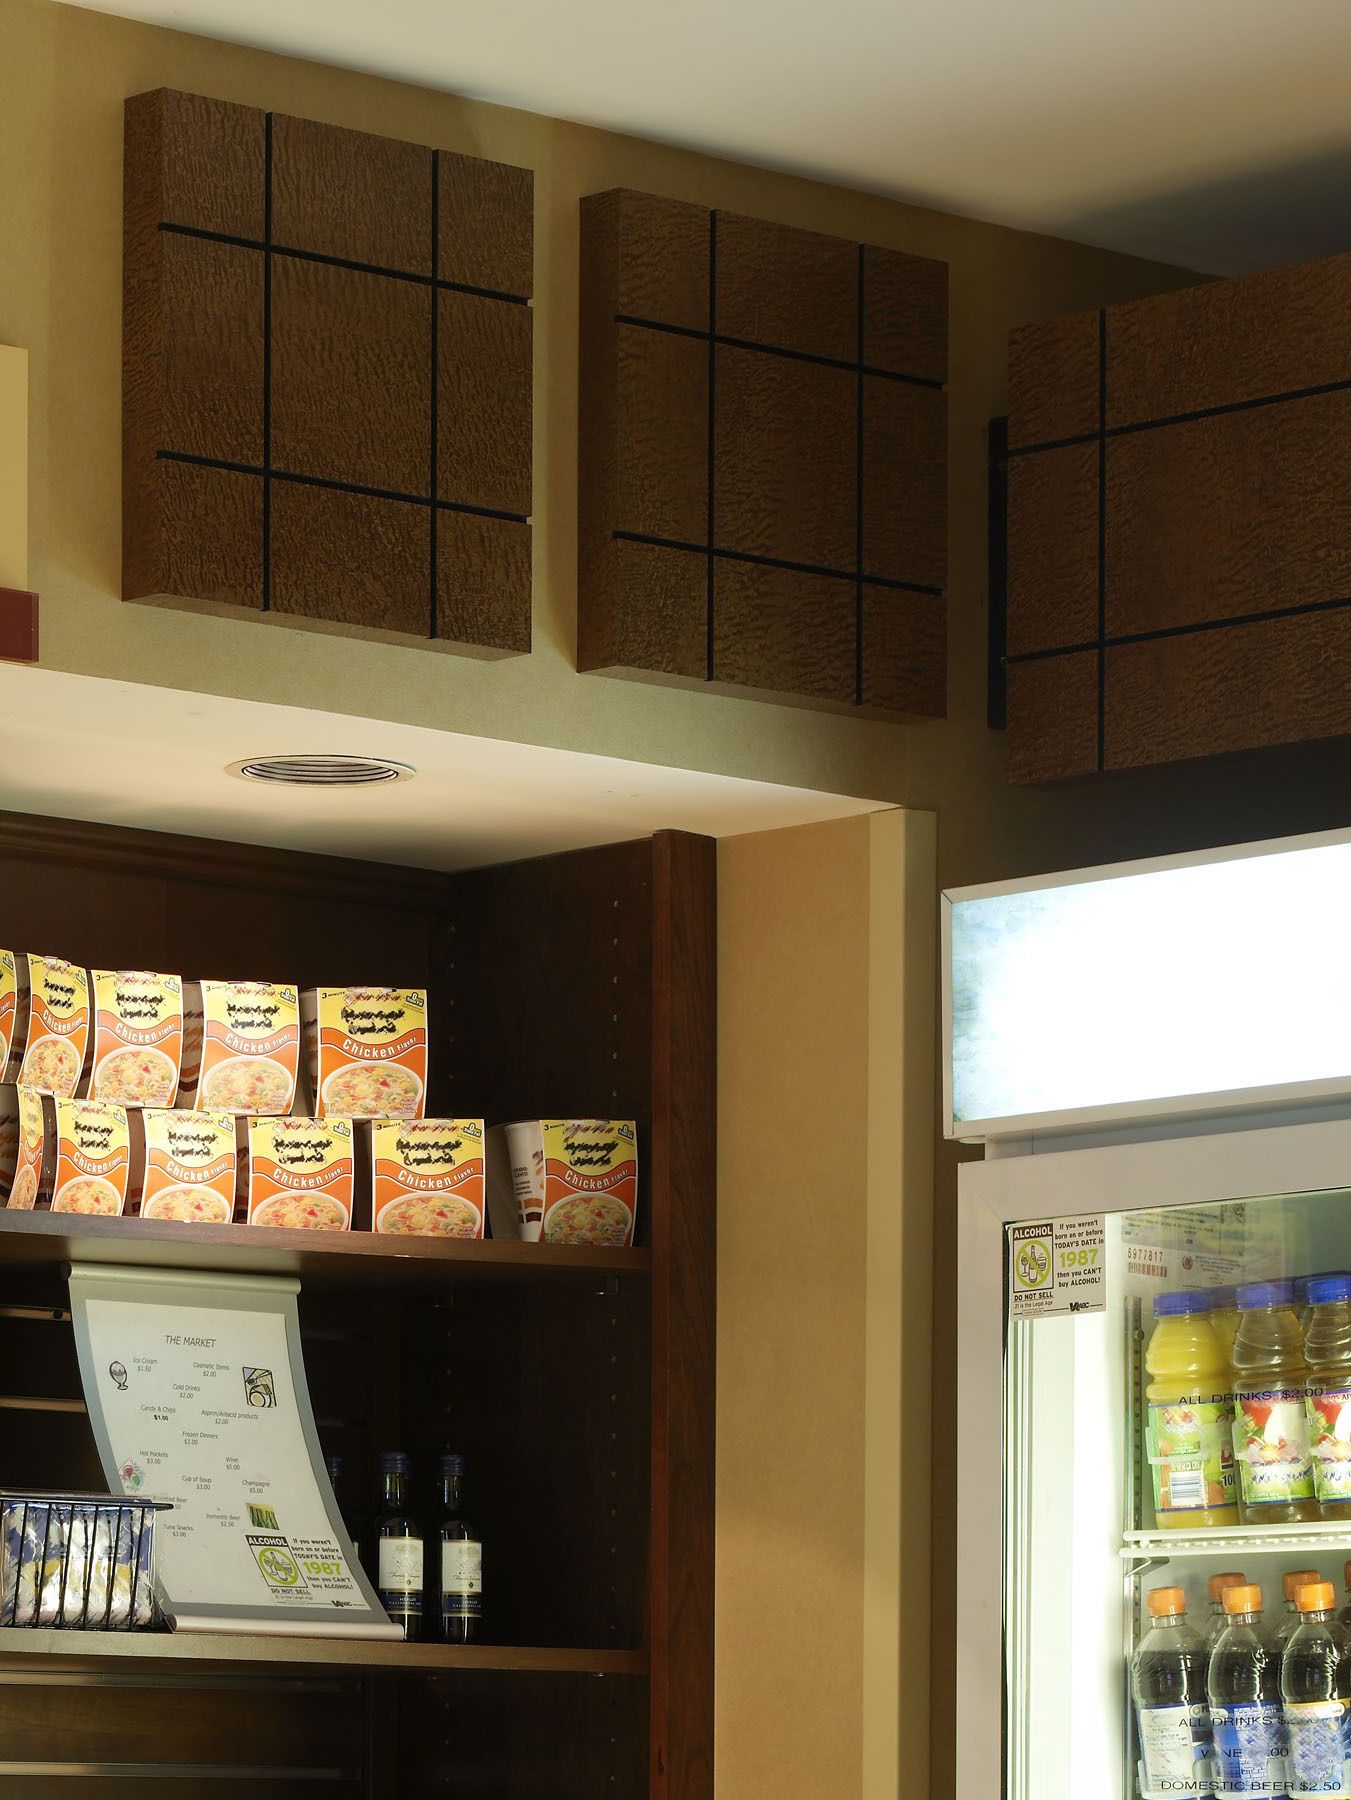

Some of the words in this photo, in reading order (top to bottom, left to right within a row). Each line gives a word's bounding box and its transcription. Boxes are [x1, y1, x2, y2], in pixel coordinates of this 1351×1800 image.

[43, 1009, 71, 1032] Chicken
[115, 1022, 157, 1043] Chicken
[226, 1033, 271, 1052] Chicken
[343, 1039, 395, 1059] Chicken
[397, 1037, 417, 1051] Flavor
[73, 1152, 107, 1172] Chicken
[167, 1161, 209, 1180] Chicken
[273, 1168, 323, 1187] Chicken
[325, 1167, 344, 1180] Flavor
[398, 1170, 451, 1189] Chicken
[454, 1167, 474, 1182] Flavor
[564, 1170, 610, 1189] Chicken
[1014, 1226, 1052, 1239] ALCOHOL
[1086, 1229, 1103, 1237] before
[1055, 1241, 1079, 1249] TODAY'S
[1060, 1248, 1099, 1268] 1987
[1128, 1248, 1163, 1262] 6977817
[1083, 1267, 1102, 1275] CAN'T
[1070, 1277, 1100, 1286] ALCOHOL!
[165, 1335, 181, 1345] THE
[183, 1337, 216, 1348] MARKET
[193, 1362, 214, 1370] Cosmetic
[1178, 1396, 1207, 1404] ALL
[1212, 1391, 1272, 1404] DRINKS
[1282, 1388, 1324, 1399] $2.00
[141, 1405, 157, 1413] Candy
[248, 1537, 288, 1546] ALCOHOL
[303, 1562, 342, 1575] 1987
[1178, 1718, 1207, 1728] ALL
[1212, 1716, 1272, 1727] DRINKS
[1161, 1780, 1246, 1791] DOMESTIC
[1251, 1781, 1294, 1791] BEER
[1300, 1780, 1341, 1791] $2.50
